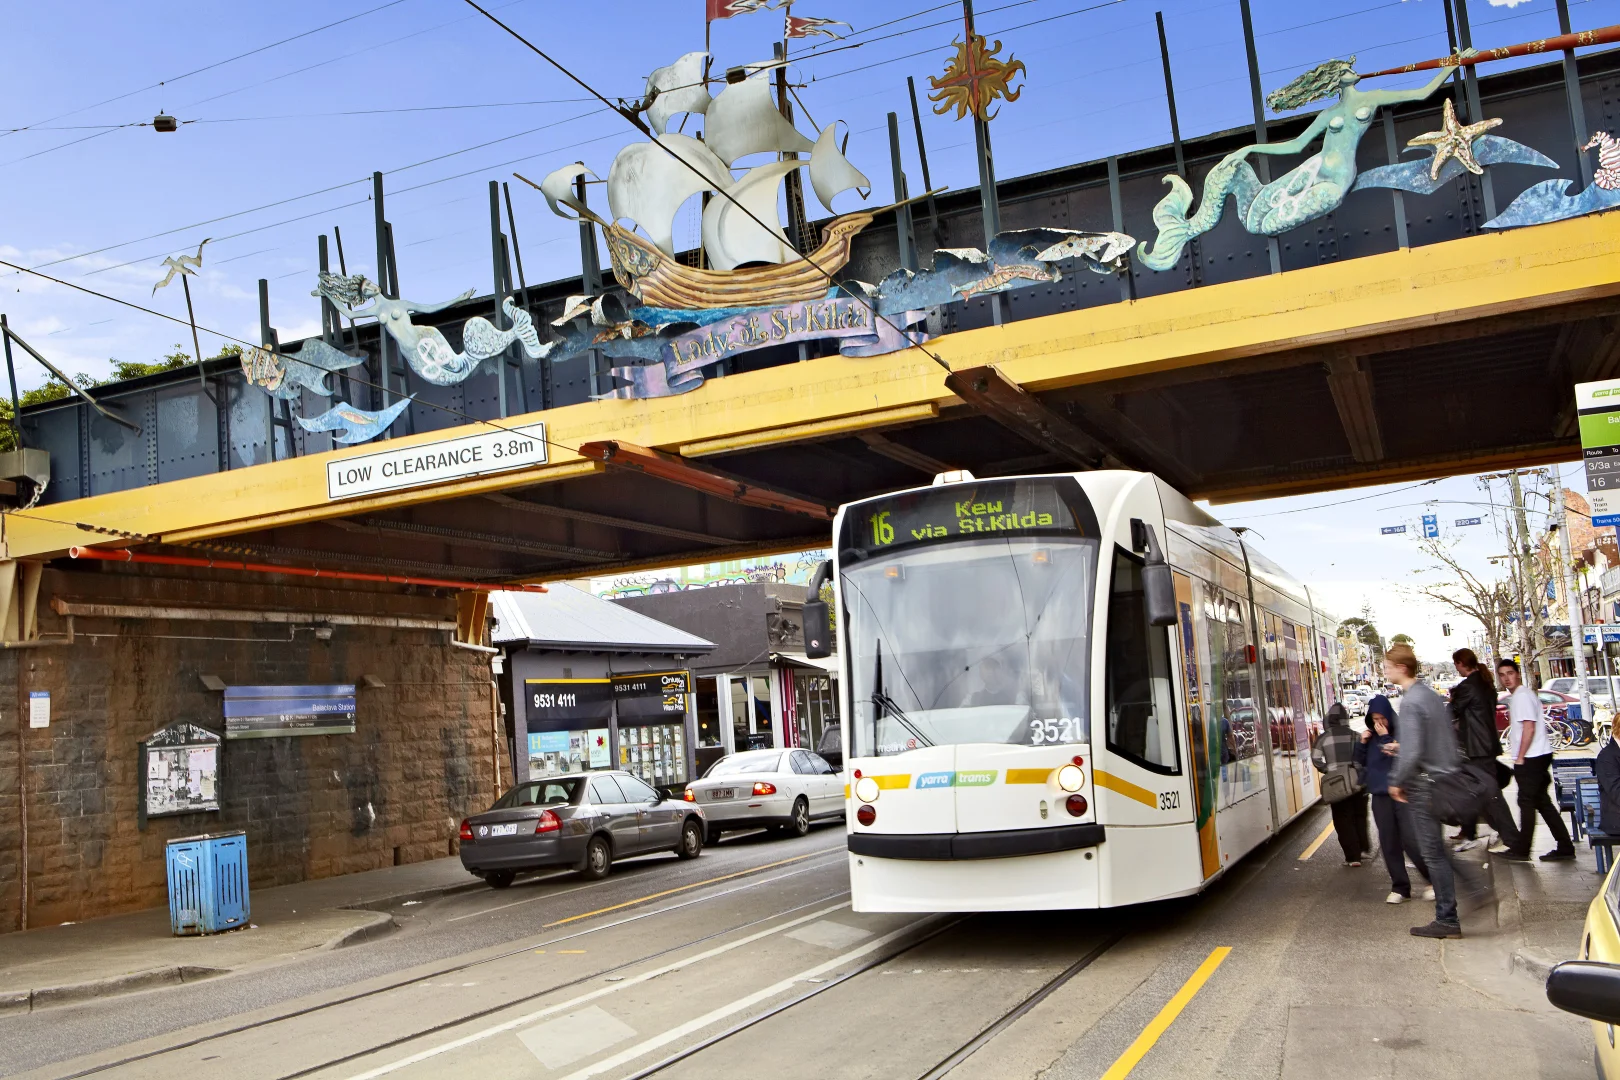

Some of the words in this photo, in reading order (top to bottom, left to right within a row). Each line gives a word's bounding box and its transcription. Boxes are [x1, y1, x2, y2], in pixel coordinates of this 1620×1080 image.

[670, 331, 731, 366] Lady
[338, 465, 373, 486] LOW
[381, 445, 483, 478] CLEARANCE
[492, 439, 534, 459] 3.8m
[1588, 461, 1611, 471] 3/3a
[1591, 477, 1606, 488] 16
[955, 500, 1003, 518] Kew
[869, 511, 895, 546] 16
[911, 524, 948, 541] via
[1425, 524, 1437, 538] P
[614, 684, 630, 692] 9531
[632, 682, 647, 691] 4111
[312, 704, 337, 712] Balaclava
[338, 703, 356, 711] Station
[534, 693, 555, 708] 9531
[557, 693, 576, 708] 4111
[662, 704, 675, 712] Wilson
[674, 703, 684, 711] Pride
[1030, 717, 1083, 745] 3521
[920, 773, 949, 788] yarra
[958, 771, 991, 784] trams
[1159, 790, 1182, 811] 3521
